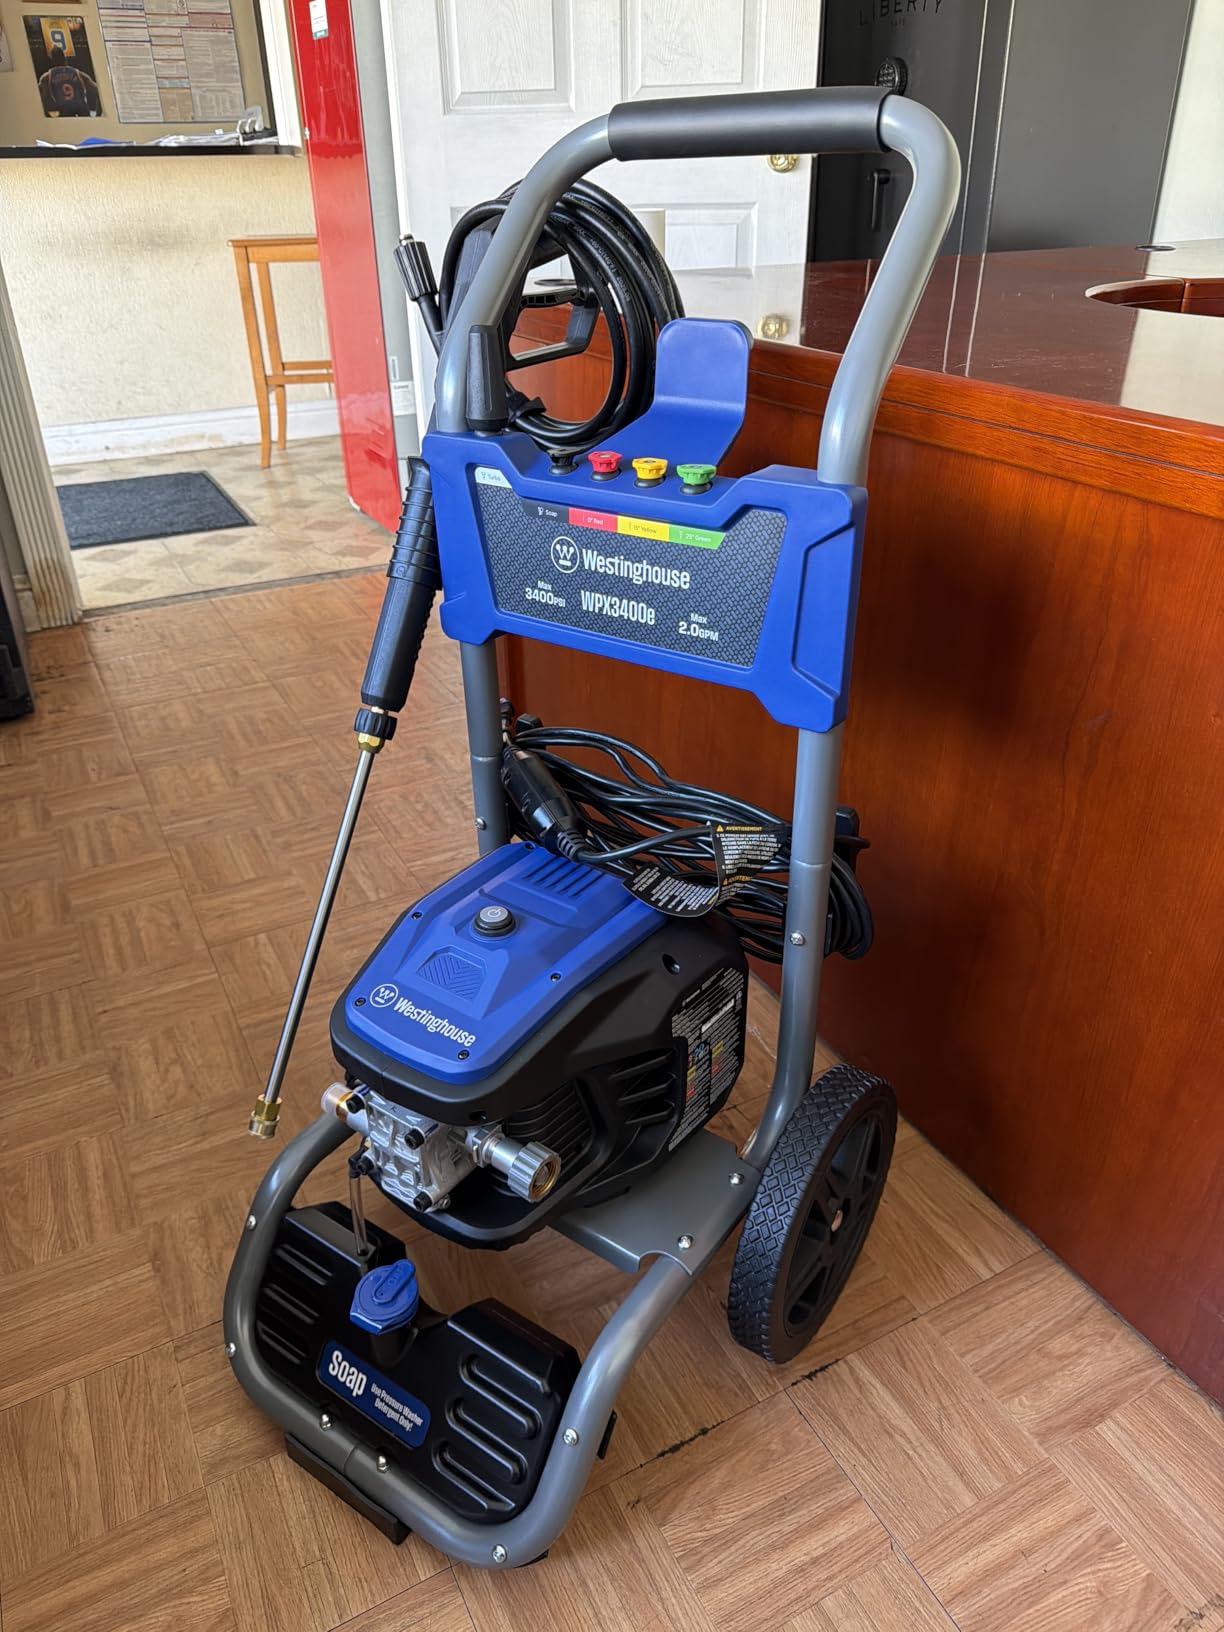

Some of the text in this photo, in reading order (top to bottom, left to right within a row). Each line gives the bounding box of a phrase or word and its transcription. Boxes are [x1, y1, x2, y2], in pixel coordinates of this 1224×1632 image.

[537, 580, 552, 590] Max
[582, 549, 690, 590] Westinghouse
[525, 587, 656, 626] 3400PSI WPX3400e
[690, 613, 707, 624] Max
[678, 621, 719, 641] 2.0GPM
[394, 997, 476, 1047] Westinghouse
[328, 1350, 367, 1397] Soap
[371, 1383, 424, 1427] Use Pressure Washer
[374, 1398, 413, 1432] Detergent Only!
